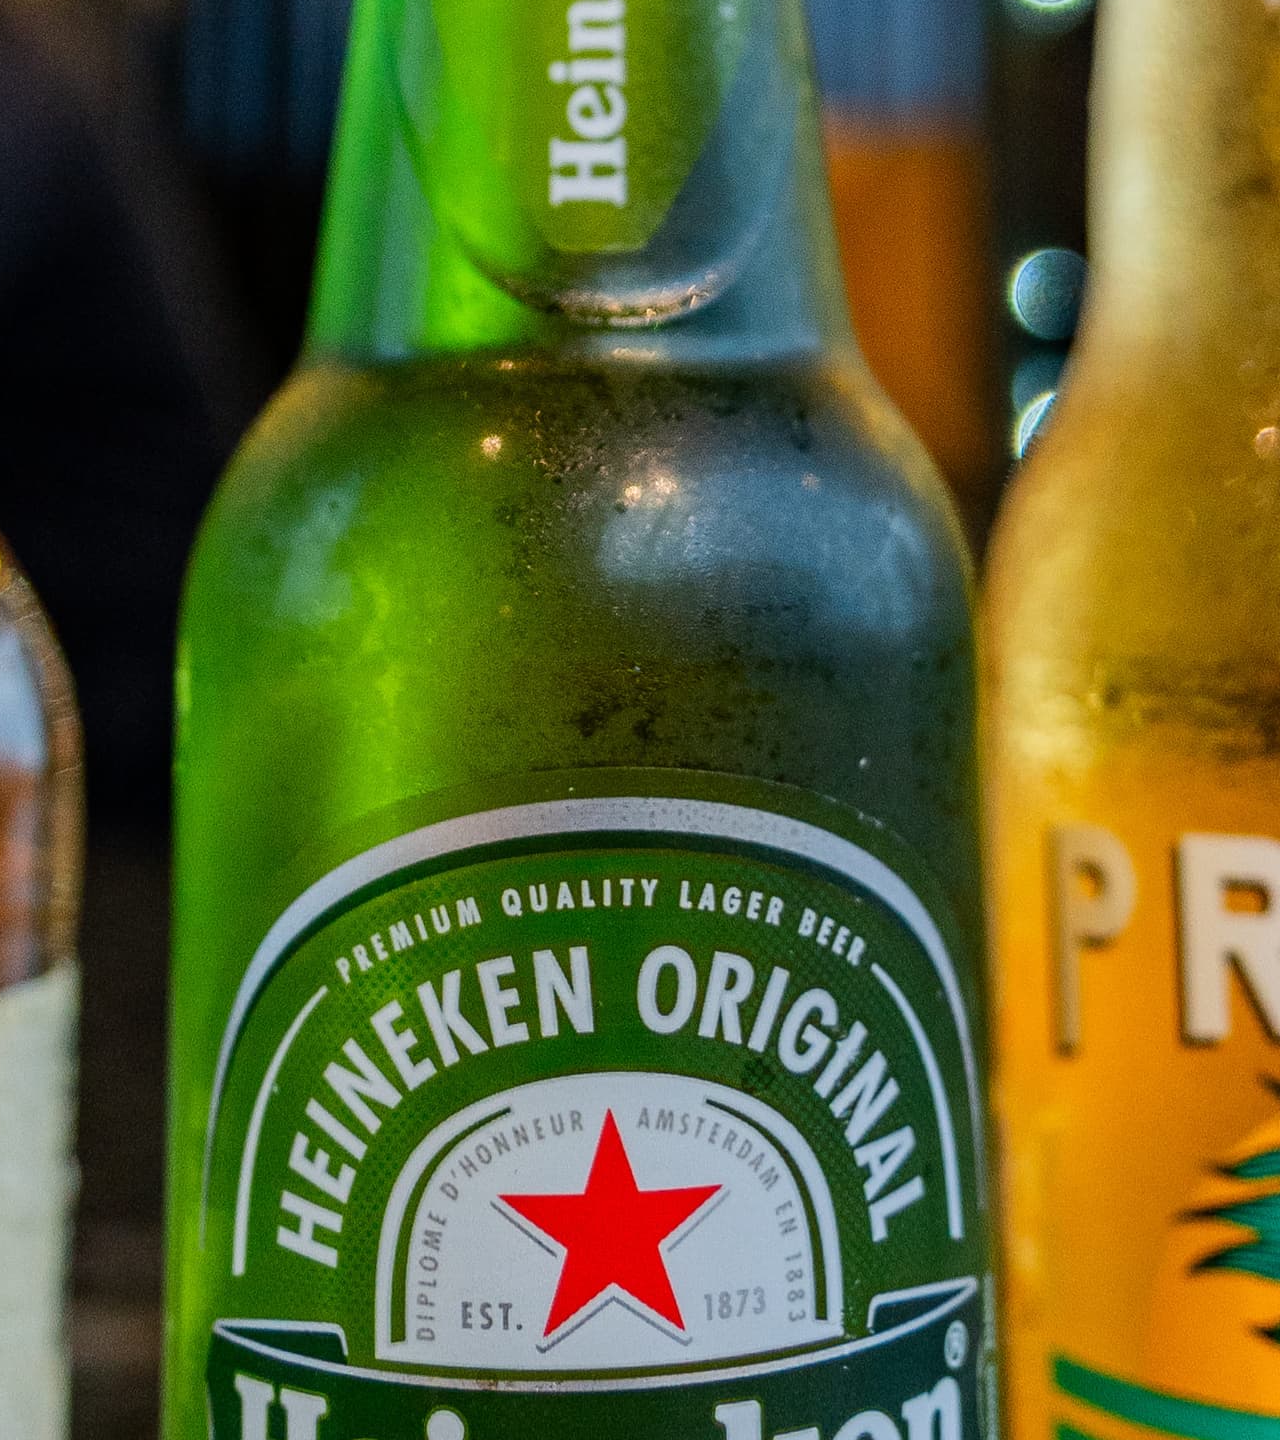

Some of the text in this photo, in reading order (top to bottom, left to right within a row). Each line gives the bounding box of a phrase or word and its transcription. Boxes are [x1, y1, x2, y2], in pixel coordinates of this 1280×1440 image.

[335, 878, 867, 985] PREMIUM QUALITY LAGER BEER
[276, 944, 926, 1269] HEINEKEN ORIGINAL
[415, 1108, 586, 1342] DIPLOME D'HONNEUR
[636, 1106, 807, 1323] AMSTERDAM EN 1883
[460, 1300, 524, 1332] EST.
[702, 1287, 767, 1323] 1873
